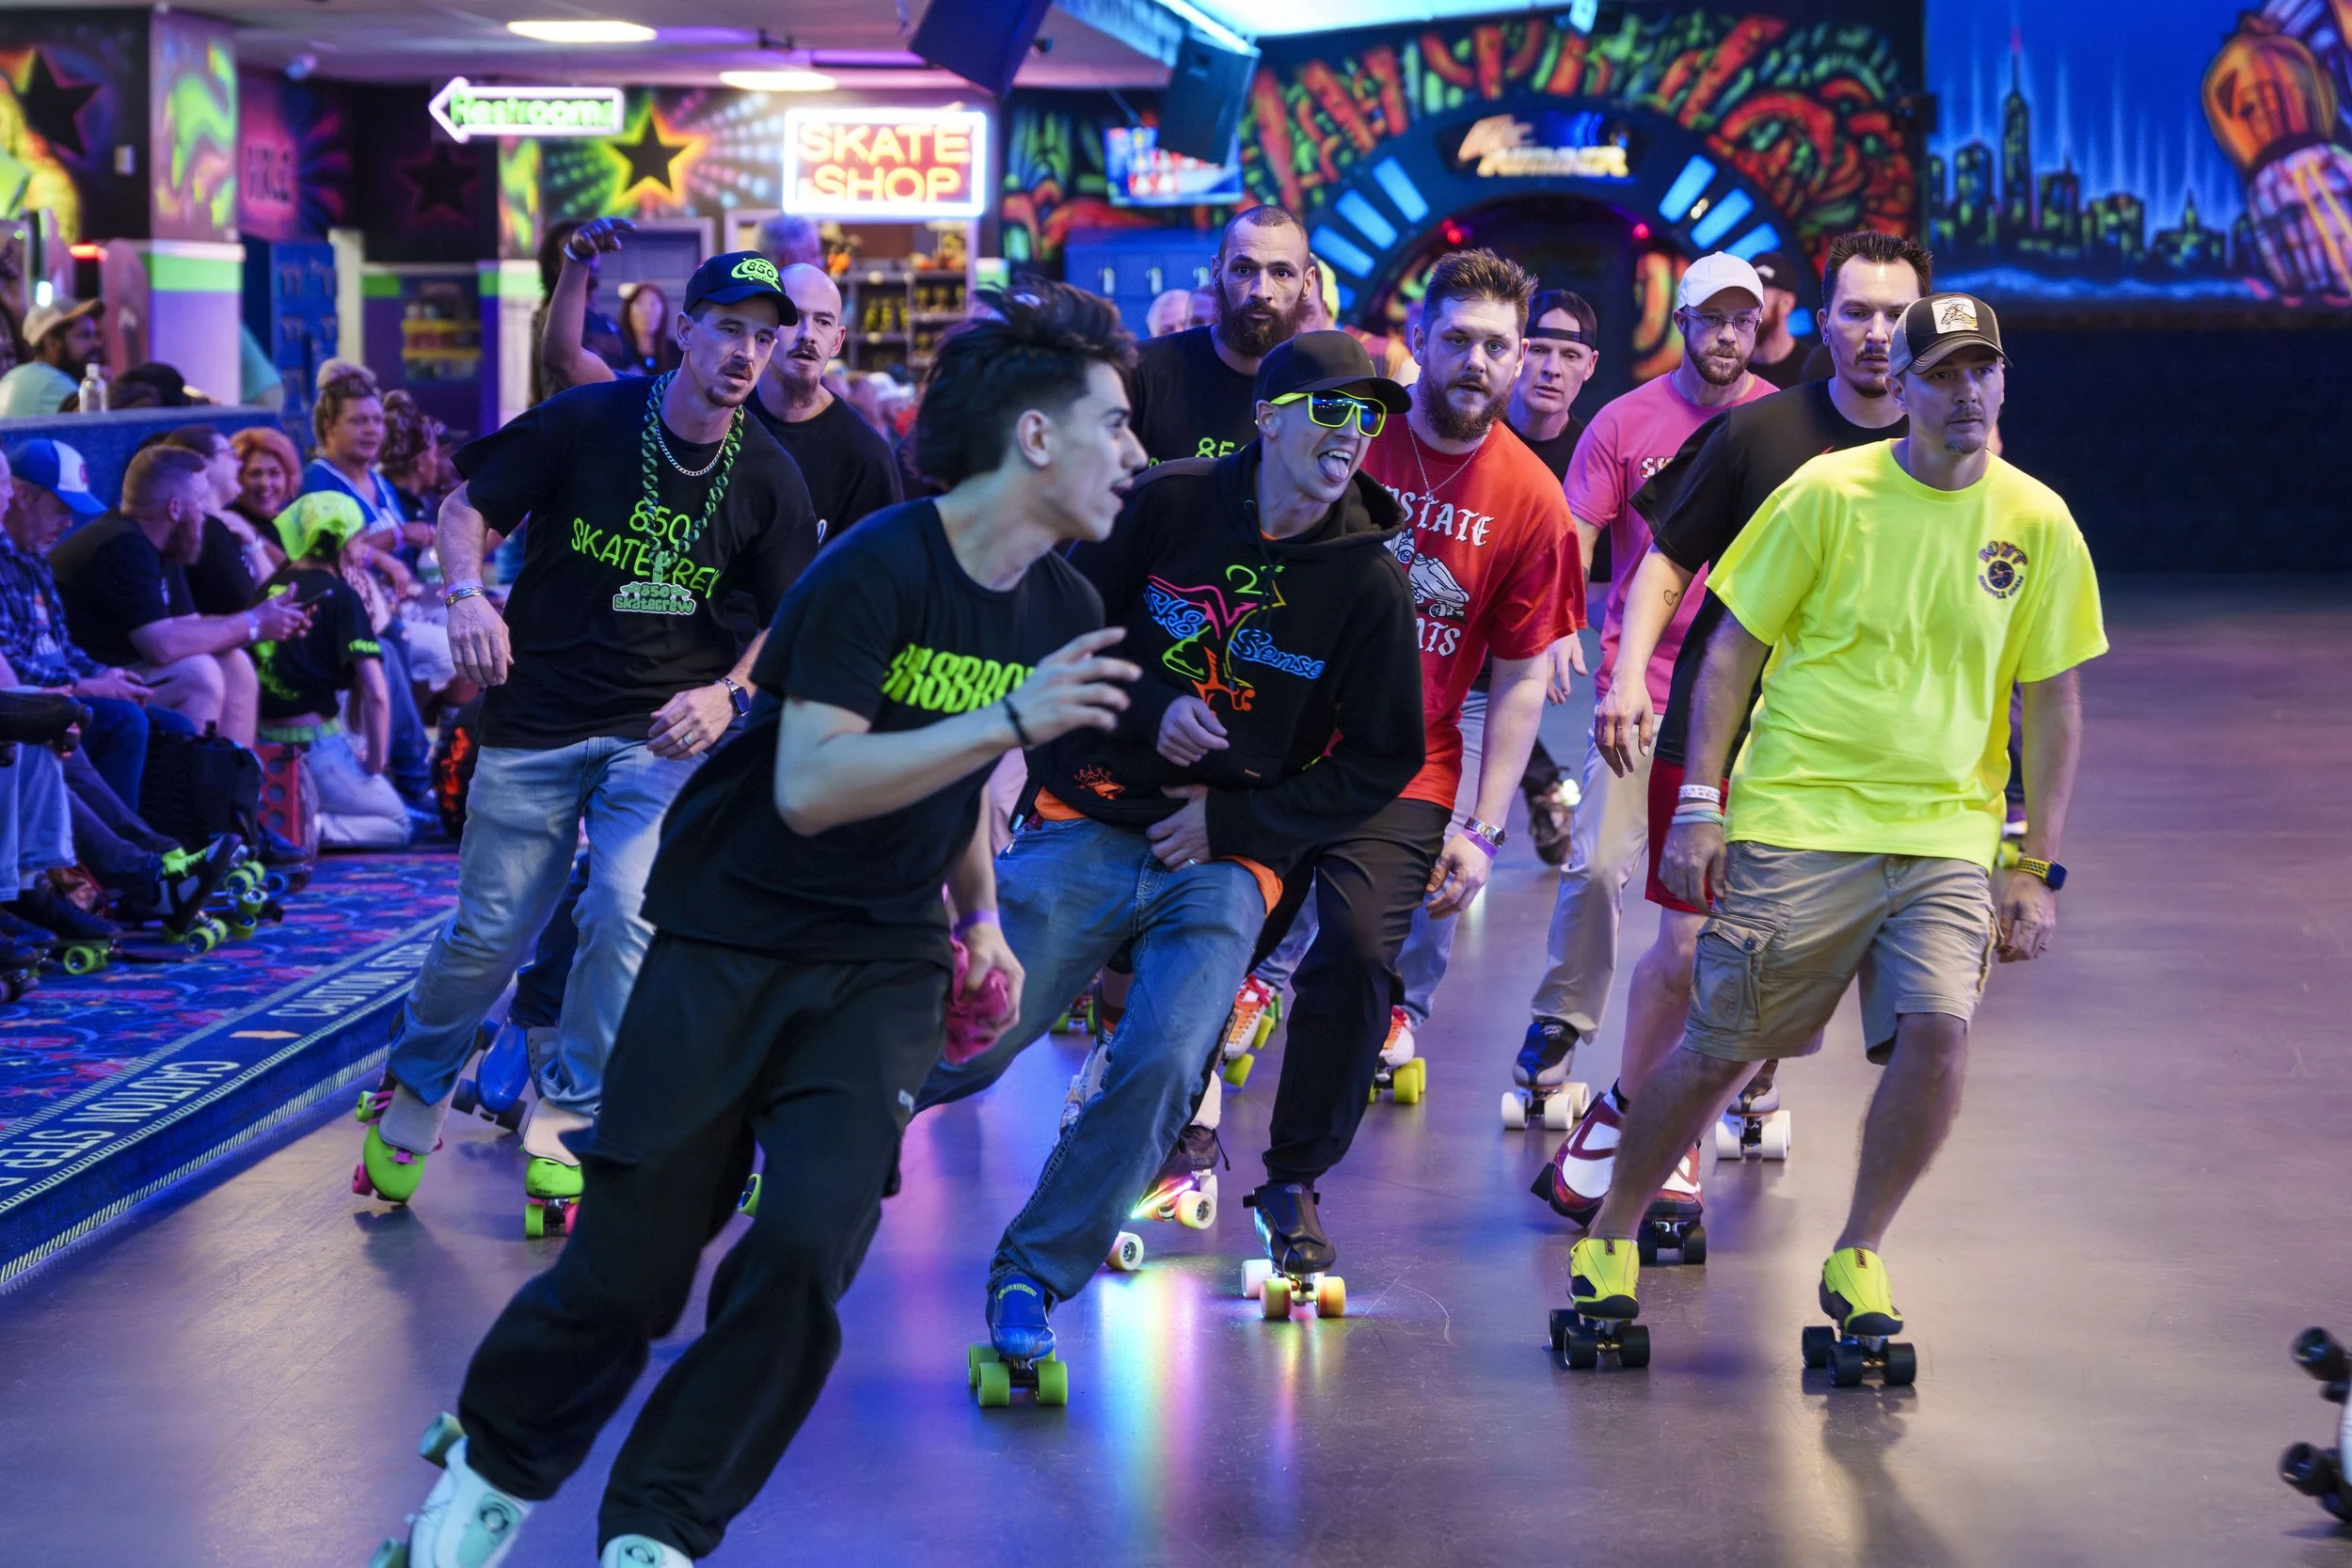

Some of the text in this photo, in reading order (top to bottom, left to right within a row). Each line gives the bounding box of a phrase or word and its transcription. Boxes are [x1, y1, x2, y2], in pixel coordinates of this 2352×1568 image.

[799, 122, 972, 166] SKATE
[813, 164, 961, 203] SHOP
[746, 261, 774, 278] 850
[1195, 436, 1248, 459] 85
[629, 499, 691, 545] 850
[571, 517, 720, 599] SKATERE
[641, 584, 671, 598] 850
[0, 1060, 241, 1168] CAUTION STEP
